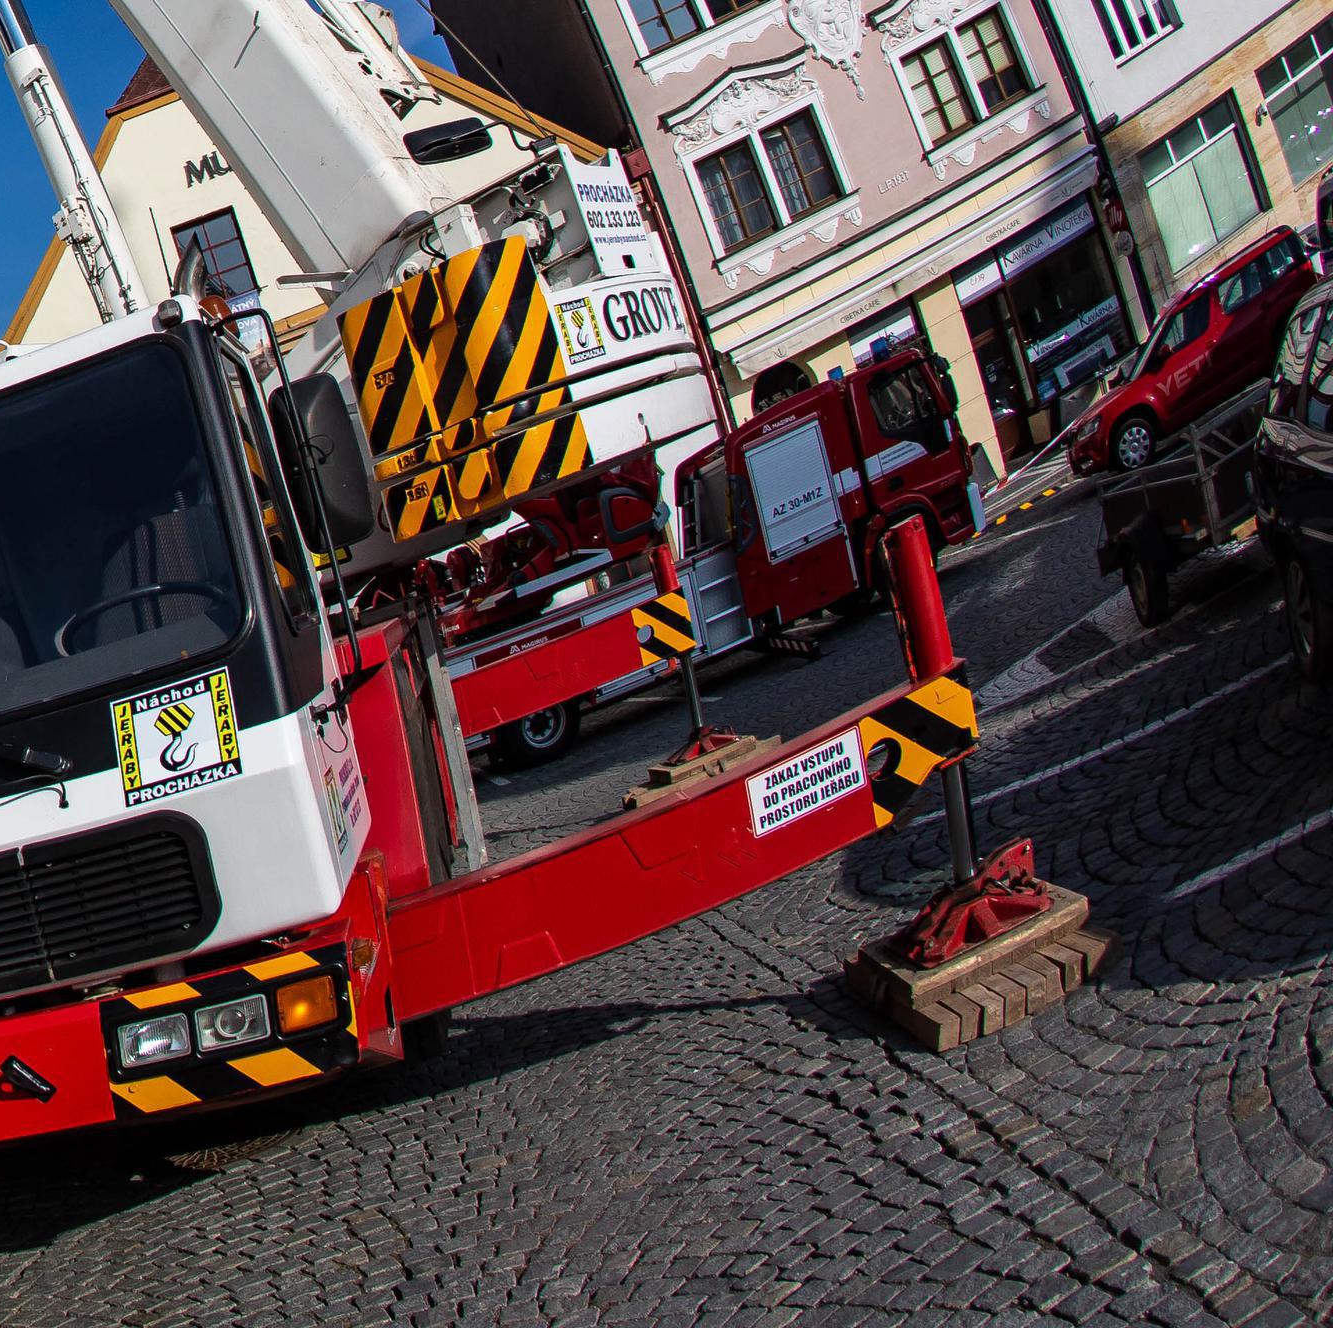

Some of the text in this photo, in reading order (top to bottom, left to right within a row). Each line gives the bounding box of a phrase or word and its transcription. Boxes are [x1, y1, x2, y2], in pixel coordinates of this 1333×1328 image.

[576, 180, 633, 203] PROCHÁZKA
[586, 210, 641, 228] 602 133 123
[1002, 209, 1090, 269] KAVÁRNA VINOTEKA
[602, 286, 683, 343] GROVE
[1157, 350, 1213, 397] YETI
[772, 486, 824, 519] AZ 30-M1Z
[135, 680, 205, 712] Náchod
[215, 676, 236, 760] JEŘÁBY
[119, 706, 139, 789] JEŘÁBY
[764, 741, 844, 790] ZÁKAZ VSTUPU
[128, 762, 238, 805] PROCHÁZKA
[760, 770, 860, 829] PROSTORU JEŘÁBU
[763, 756, 851, 809] DO PRACOVNÍHO
